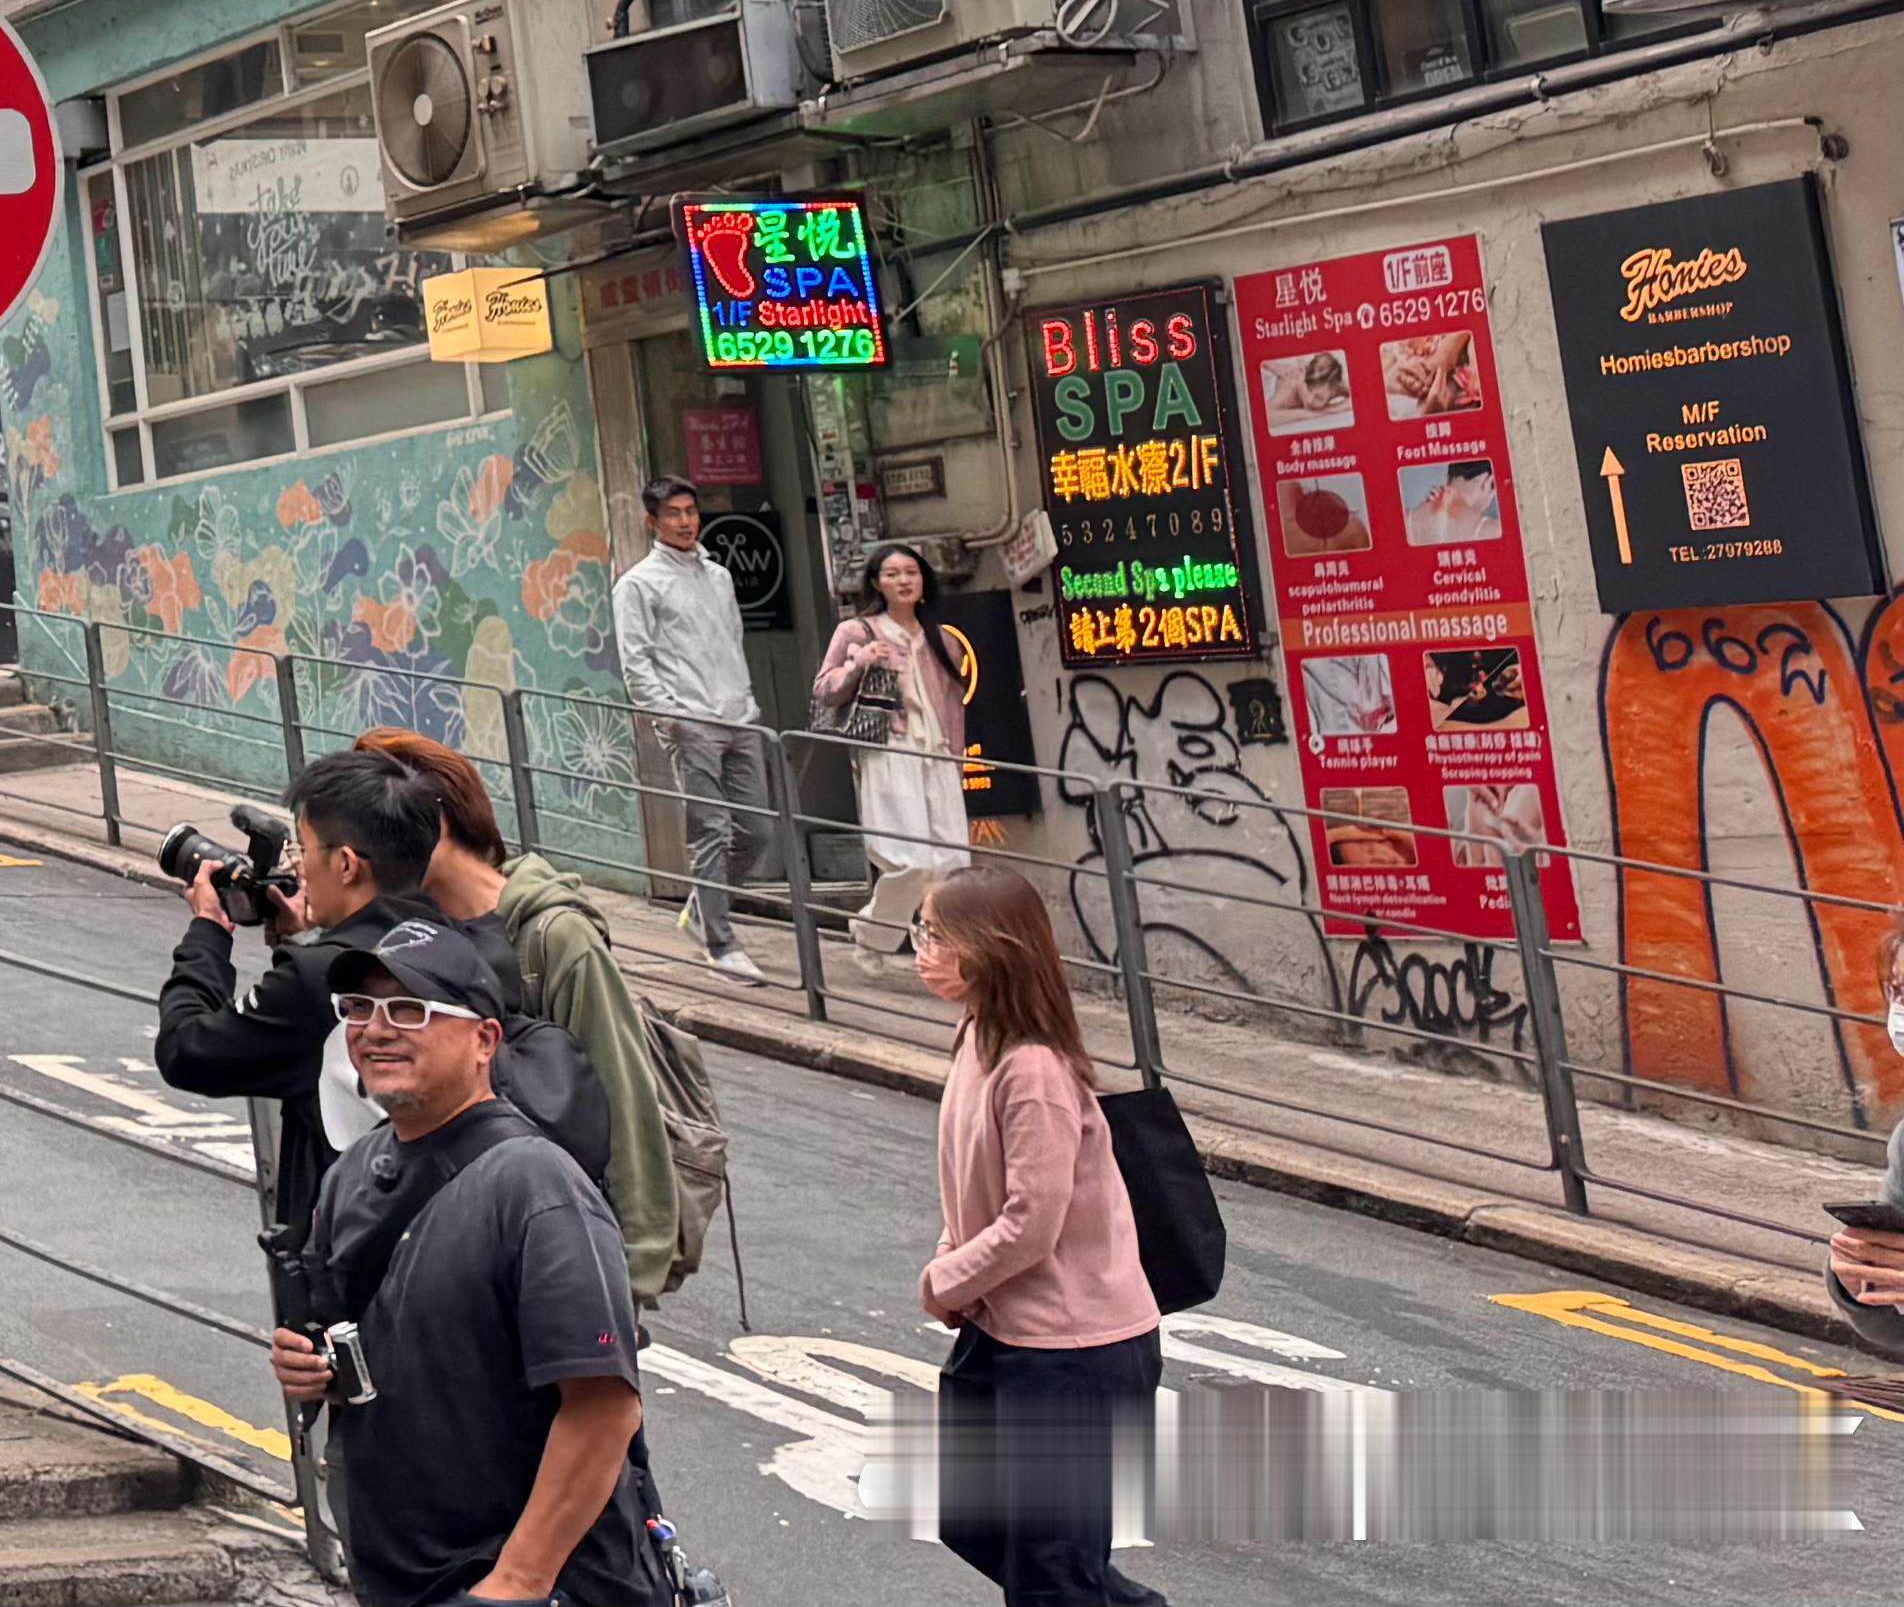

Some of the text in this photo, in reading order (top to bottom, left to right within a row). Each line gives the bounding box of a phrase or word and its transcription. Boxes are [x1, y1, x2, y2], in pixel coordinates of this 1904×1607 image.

[764, 267, 859, 298] SPA
[1620, 247, 1747, 322] Homies
[759, 299, 868, 330] Starlight
[1380, 287, 1485, 327] 6529 1276
[1648, 302, 1733, 324] BARBERSHOP
[1255, 307, 1352, 339] Starlight Spa
[718, 329, 876, 361] 6529 1276
[1042, 308, 1196, 377] Bliss
[1600, 334, 1792, 376] Homiesbarbershop
[1055, 361, 1202, 441] SPA
[1681, 401, 1720, 425] M/F
[1397, 446, 1427, 460] Foot
[1646, 424, 1767, 453] Reservation
[1276, 460, 1305, 475] Body
[1433, 568, 1486, 585] Cervical
[1302, 612, 1508, 646] Professional massage
